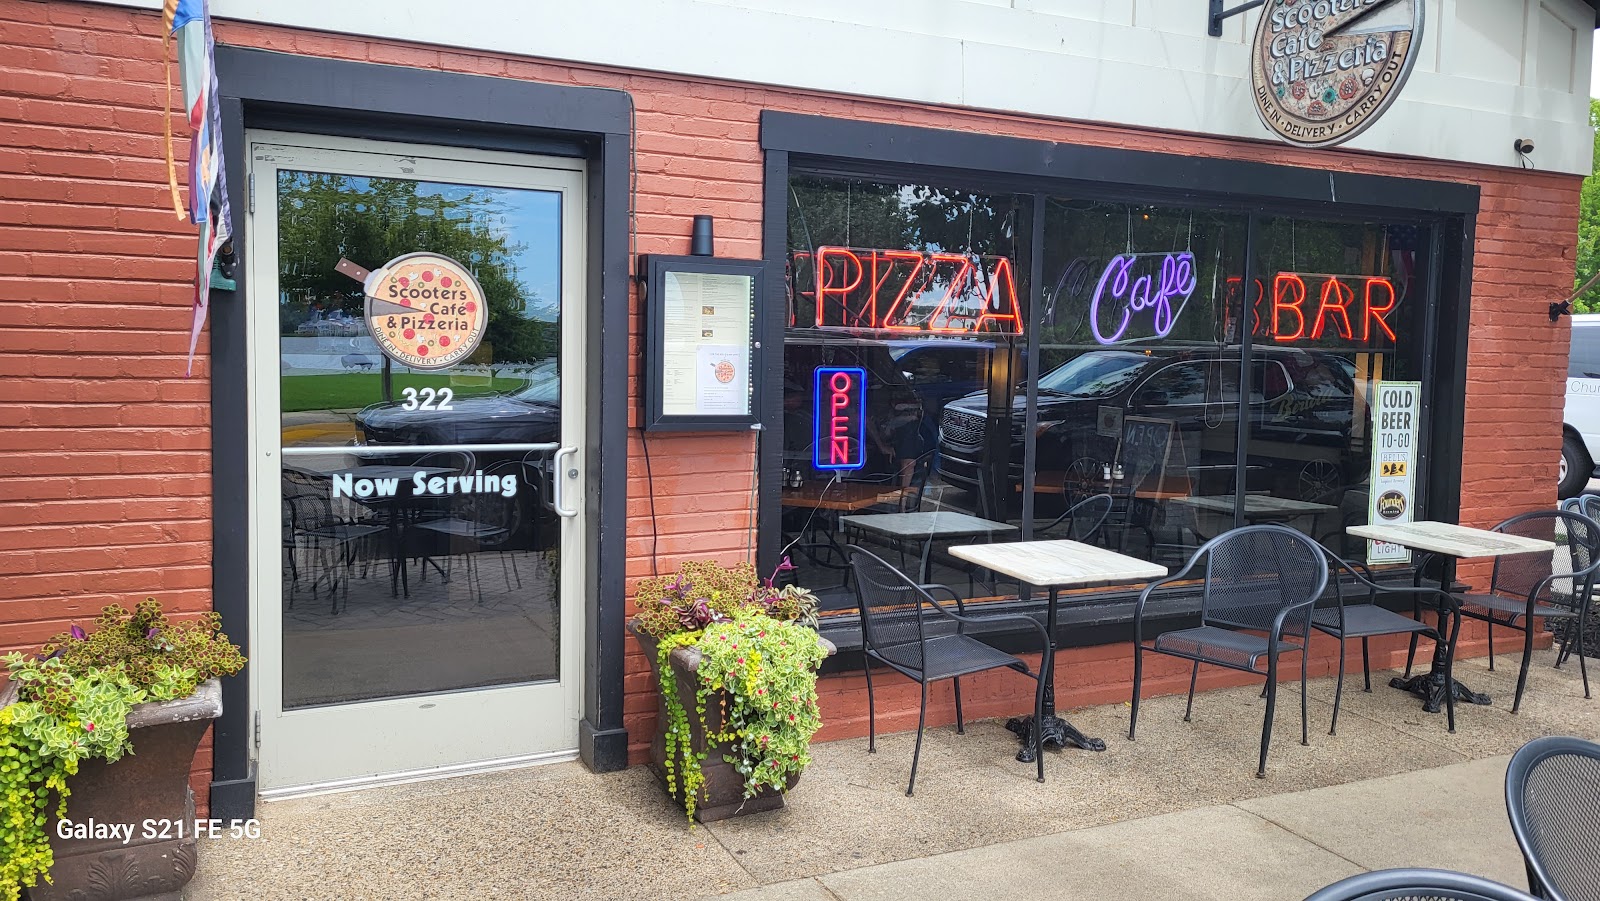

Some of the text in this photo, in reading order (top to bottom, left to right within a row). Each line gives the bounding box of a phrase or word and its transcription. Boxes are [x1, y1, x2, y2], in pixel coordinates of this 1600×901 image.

[1271, 0, 1376, 33] Scoote
[1270, 22, 1324, 59] Café
[1272, 38, 1387, 86] & Pizzeria
[1257, 51, 1402, 138] DINE IN DELIVERY CARRY OUT
[388, 284, 467, 300] Scooters
[817, 247, 1023, 335] PIZZA
[429, 302, 467, 316] Café
[1274, 274, 1396, 342] BAR
[387, 316, 469, 331] & Pizzeria
[374, 326, 480, 365] DINE IN DELIVERY CARRY OUT
[401, 387, 454, 411] 322
[1383, 390, 1413, 408] COLD
[829, 371, 852, 465] OPEN
[1381, 411, 1410, 430] BEER
[1381, 433, 1410, 448] TO-GO
[332, 469, 517, 498] Now Serving
[1377, 545, 1400, 554] LIGHT
